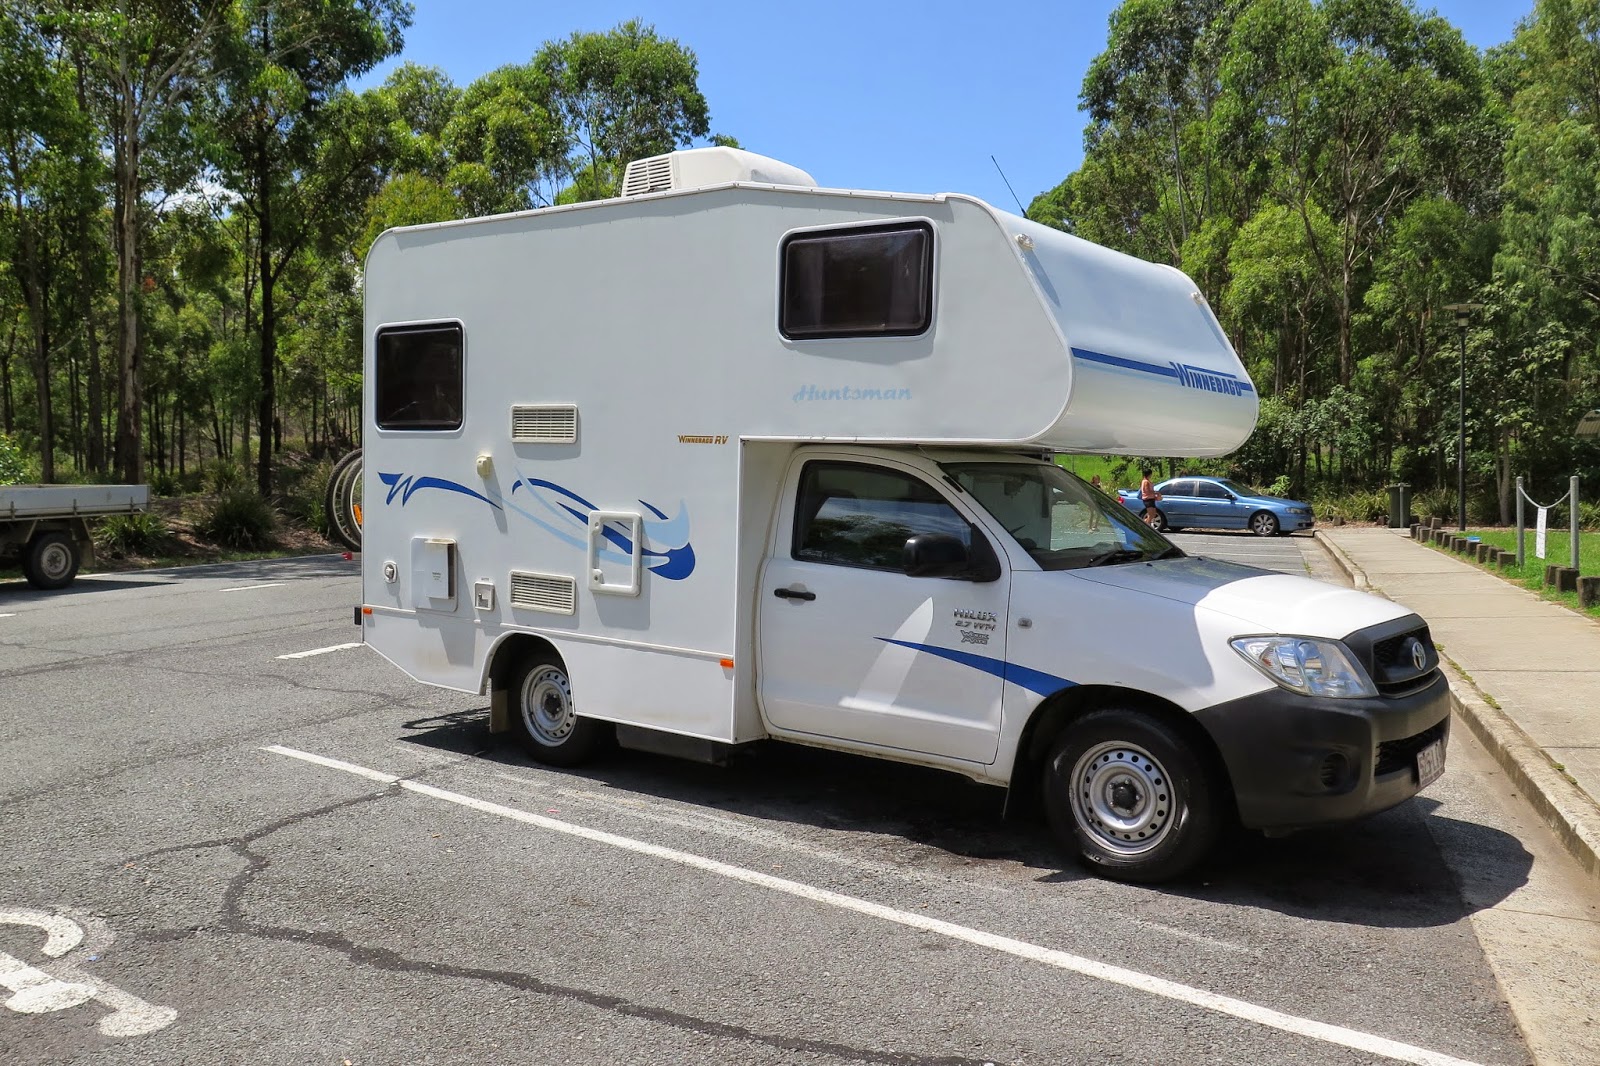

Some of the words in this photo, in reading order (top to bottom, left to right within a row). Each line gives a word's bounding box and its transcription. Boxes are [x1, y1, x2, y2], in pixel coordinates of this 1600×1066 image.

[1168, 360, 1242, 397] WINNEBAGO
[792, 384, 912, 403] Huntsman
[677, 434, 714, 444] WINNEBAGO
[714, 435, 729, 445] RV
[953, 608, 997, 622] HILUX
